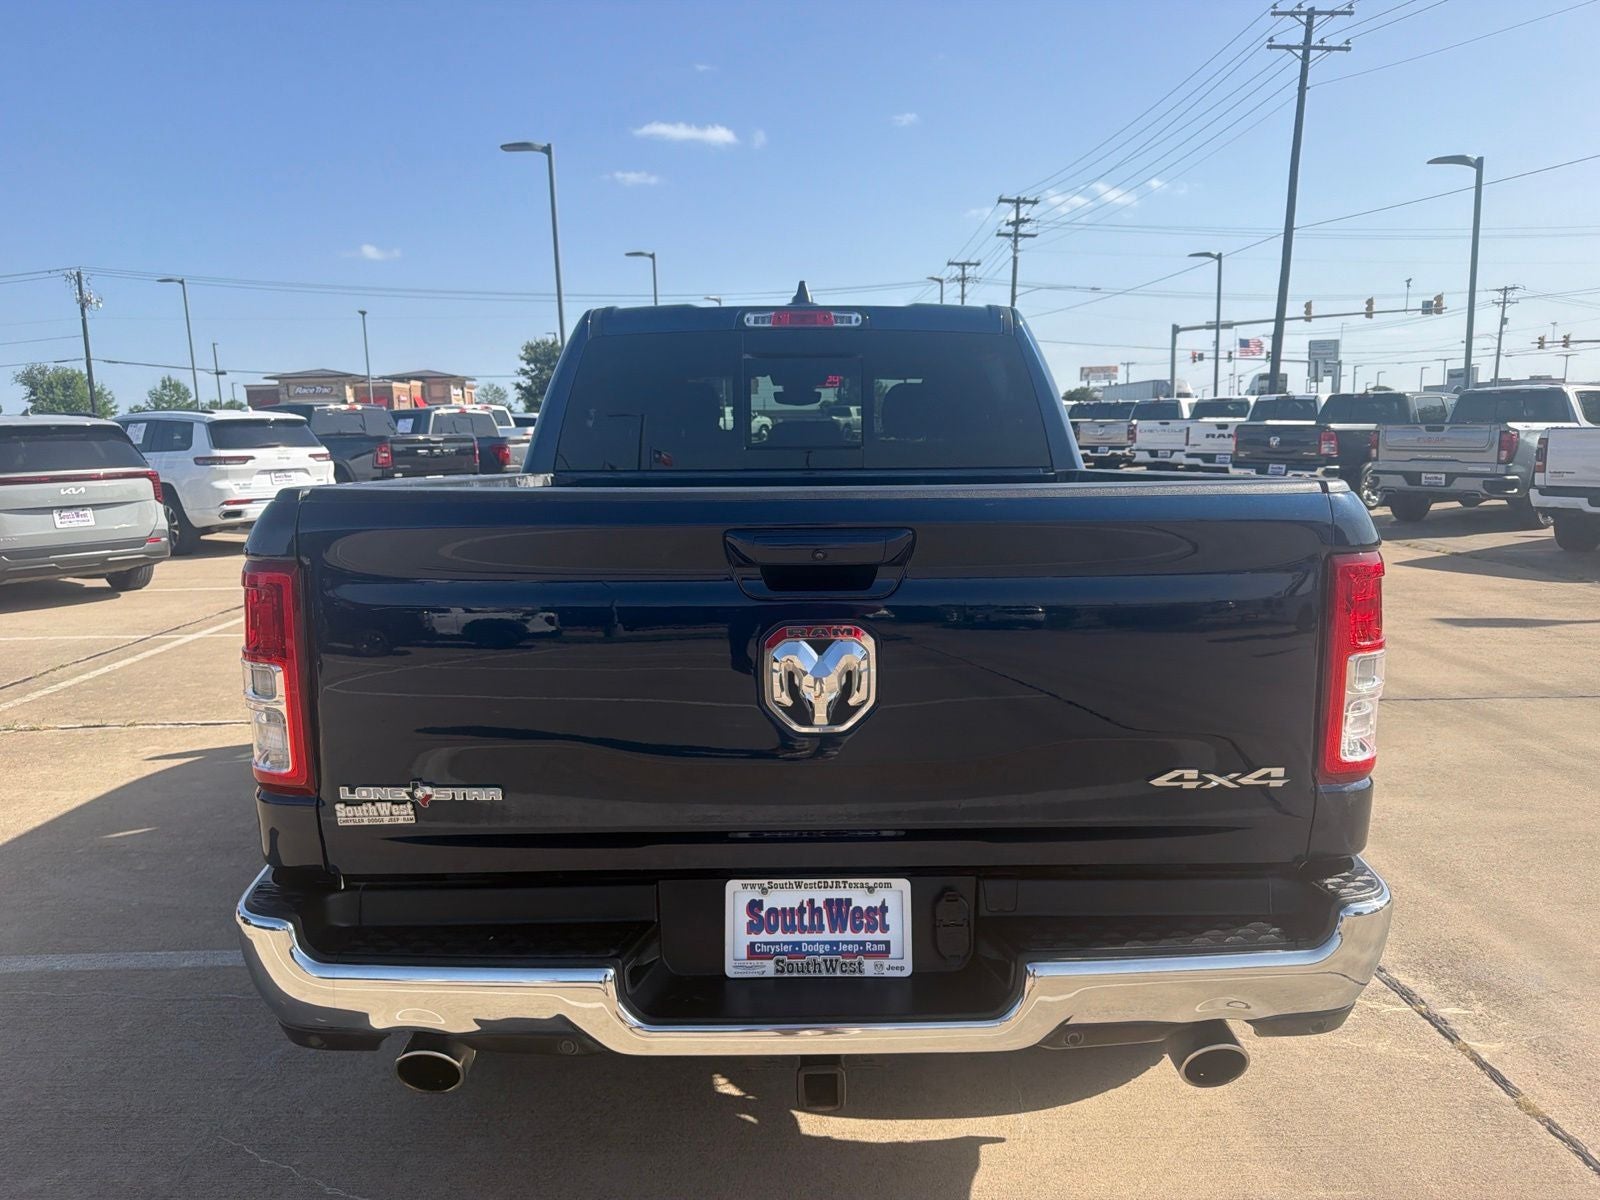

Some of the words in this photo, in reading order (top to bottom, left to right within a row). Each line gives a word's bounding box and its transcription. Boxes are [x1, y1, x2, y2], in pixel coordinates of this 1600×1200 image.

[785, 626, 854, 638] RAM
[1148, 767, 1291, 789] 4x4
[339, 786, 411, 801] LONE
[432, 787, 503, 801] STAR
[334, 801, 414, 818] SouthWest
[746, 897, 890, 936] SouthWest
[754, 943, 793, 955] Chrysler
[801, 942, 830, 954] Dodge
[838, 942, 859, 953] Jeep
[865, 941, 886, 951] Ram
[774, 957, 865, 976] SouthWest
[885, 964, 906, 972] Jeep
